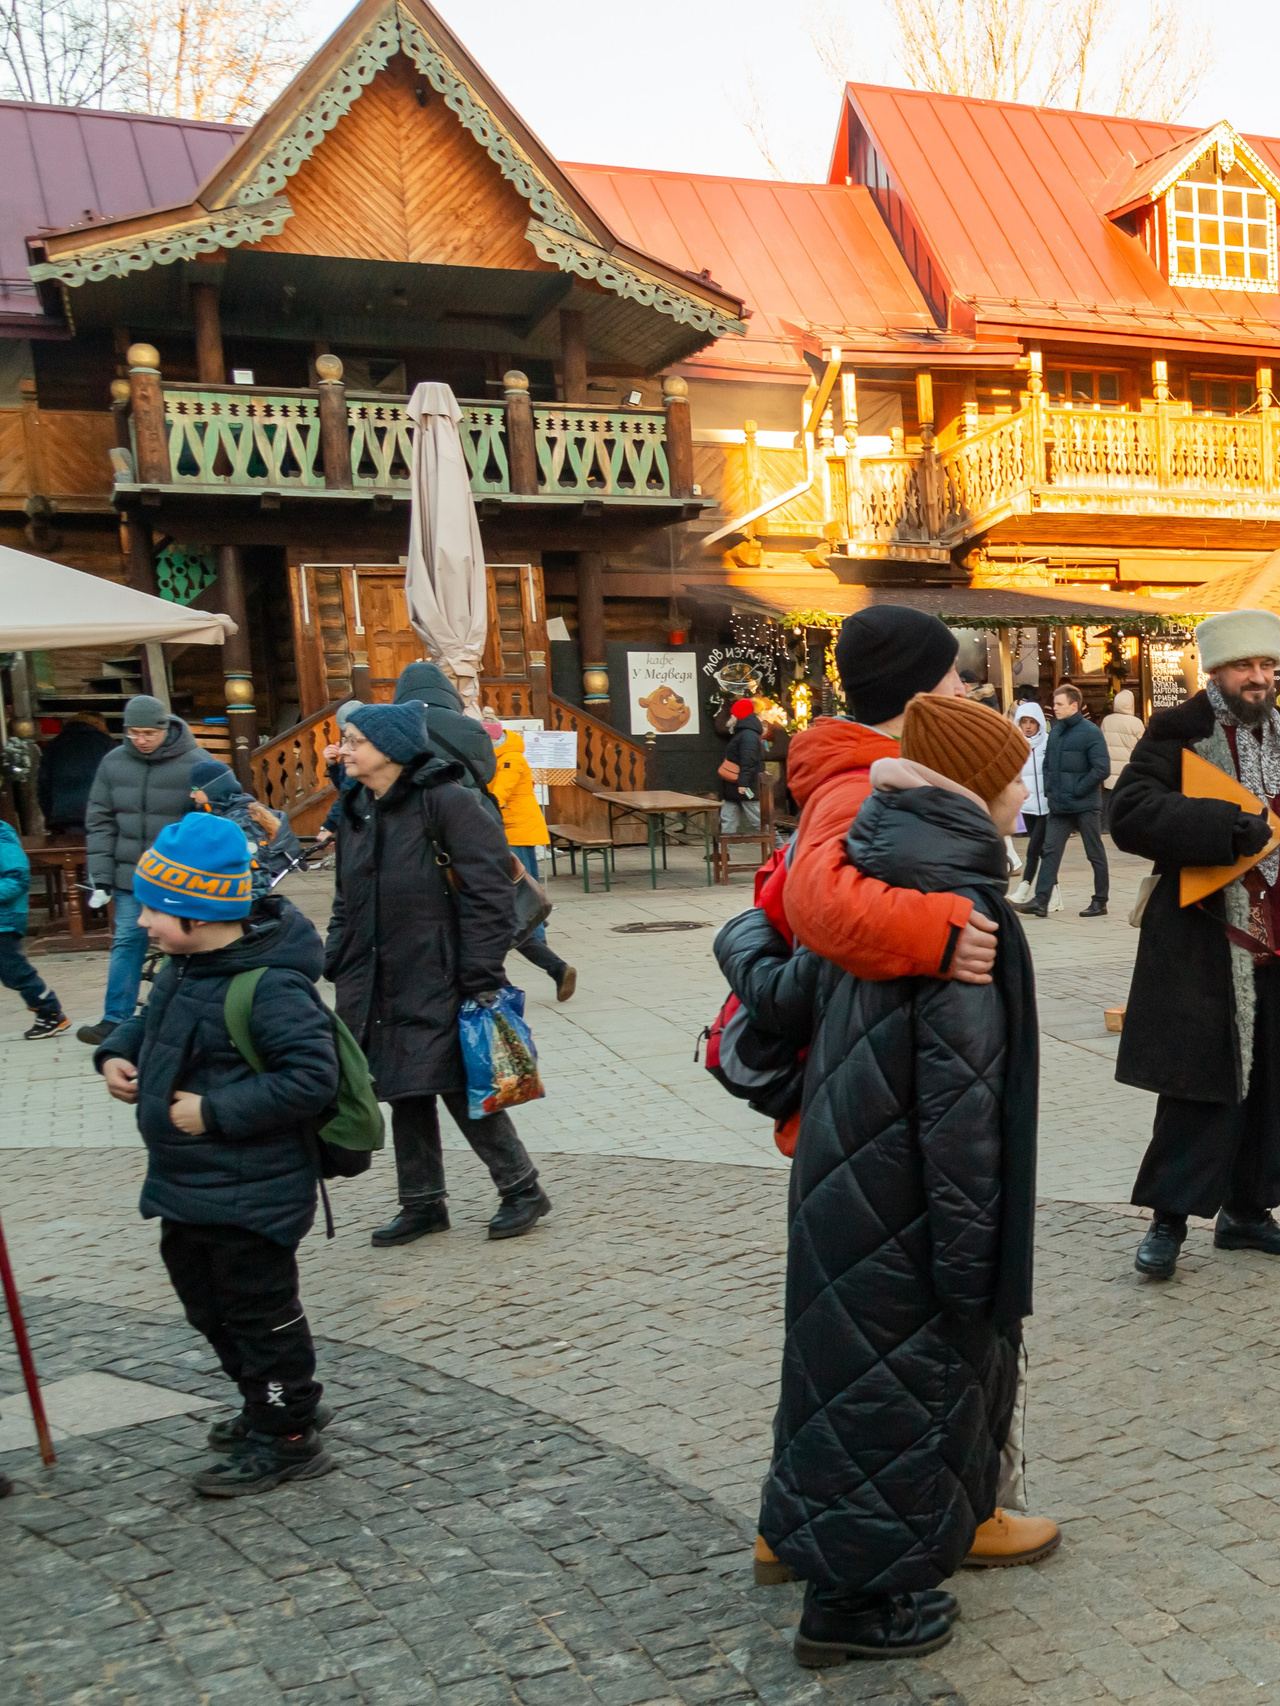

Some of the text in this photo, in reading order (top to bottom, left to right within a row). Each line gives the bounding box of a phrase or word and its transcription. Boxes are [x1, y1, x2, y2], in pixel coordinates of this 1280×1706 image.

[646, 653, 674, 669] кафе
[702, 648, 724, 676] ПЛОВ
[745, 648, 776, 686] КАЗАНА
[632, 668, 693, 683] У Медведя
